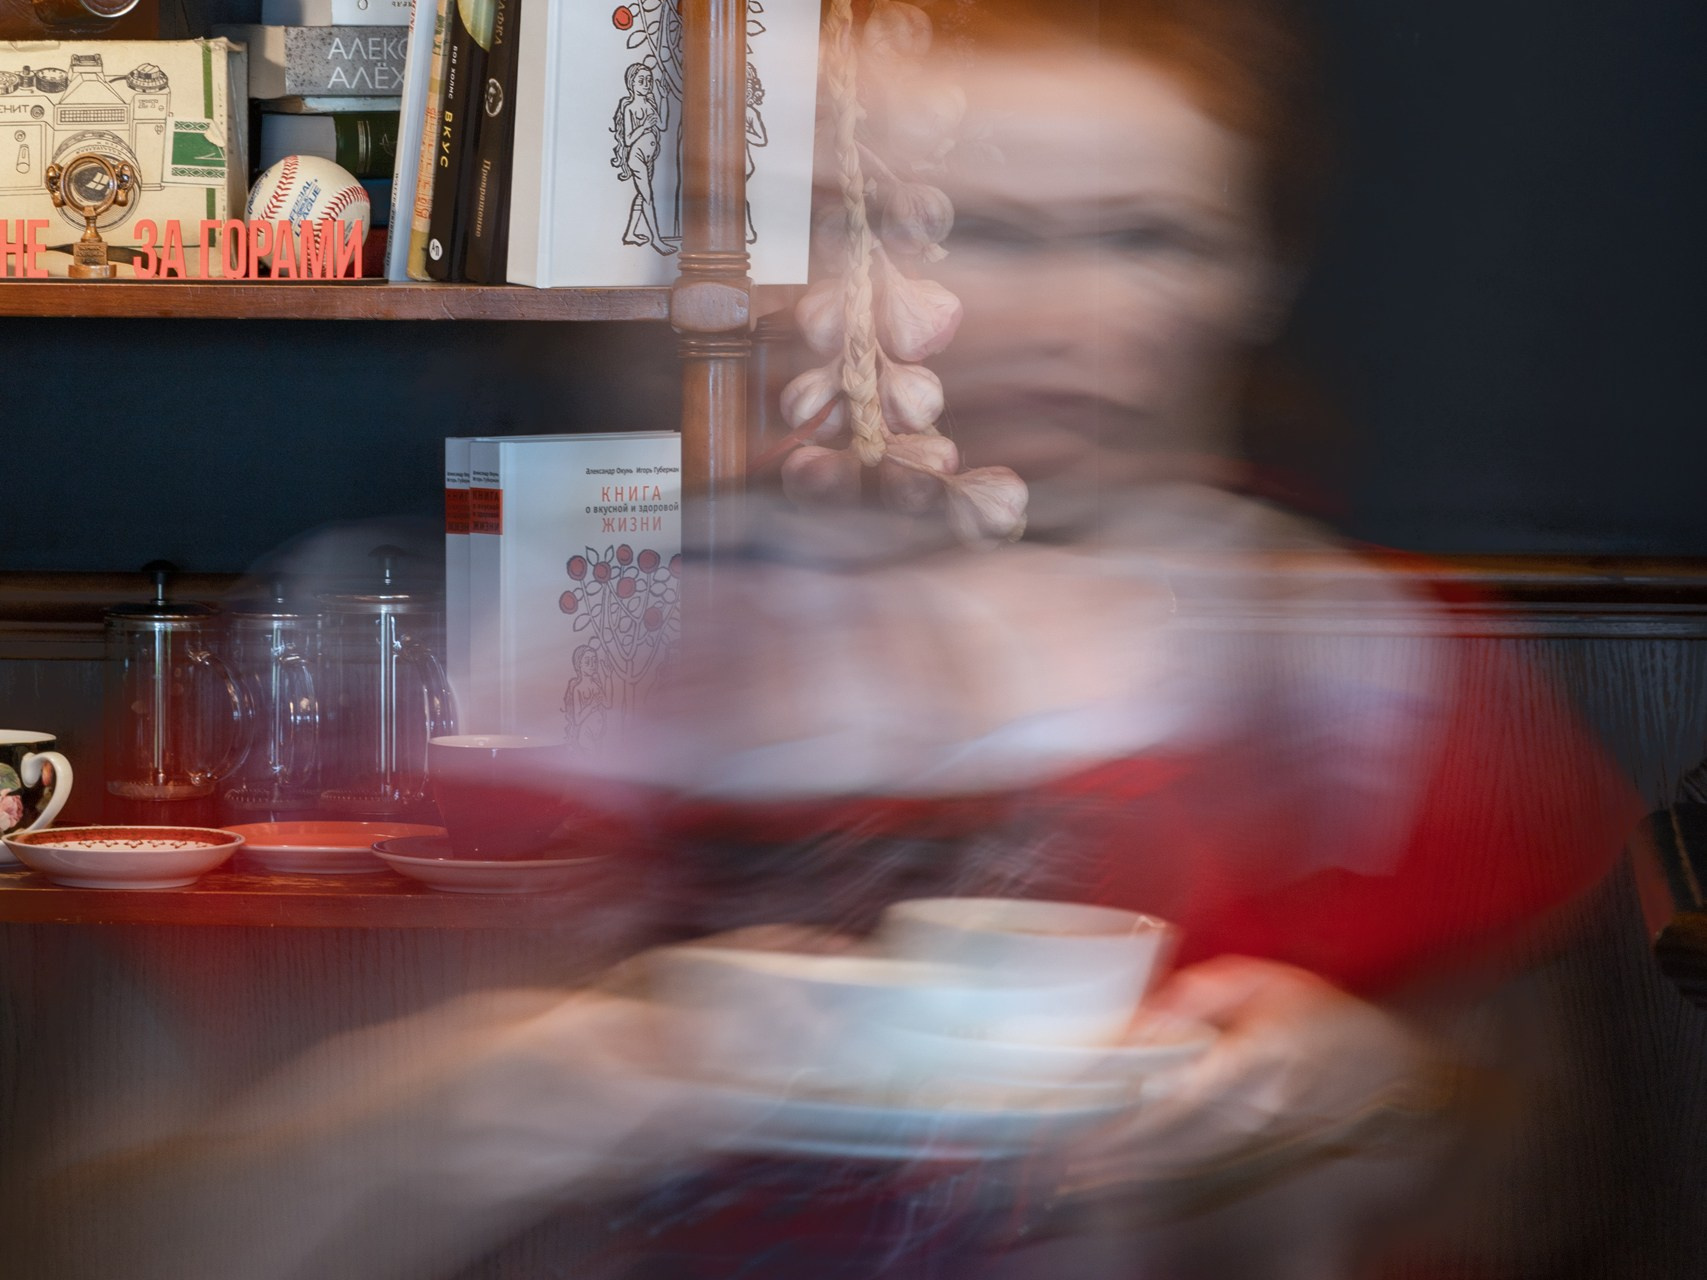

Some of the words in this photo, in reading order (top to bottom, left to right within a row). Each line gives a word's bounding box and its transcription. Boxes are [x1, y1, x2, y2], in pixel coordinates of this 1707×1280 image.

[440, 110, 453, 168] ВКУС
[287, 179, 314, 224] FFICIAL
[475, 159, 491, 237] Превращение
[0, 219, 49, 279] НЕ
[132, 218, 187, 279] ЗА
[200, 219, 363, 280] ГОРАМИ
[585, 506, 591, 514] о
[593, 503, 628, 516] вкусной
[631, 505, 636, 513] и
[638, 502, 680, 513] здоровой
[602, 485, 661, 503] КНИГА
[602, 516, 662, 534] ЖИЗНИ
